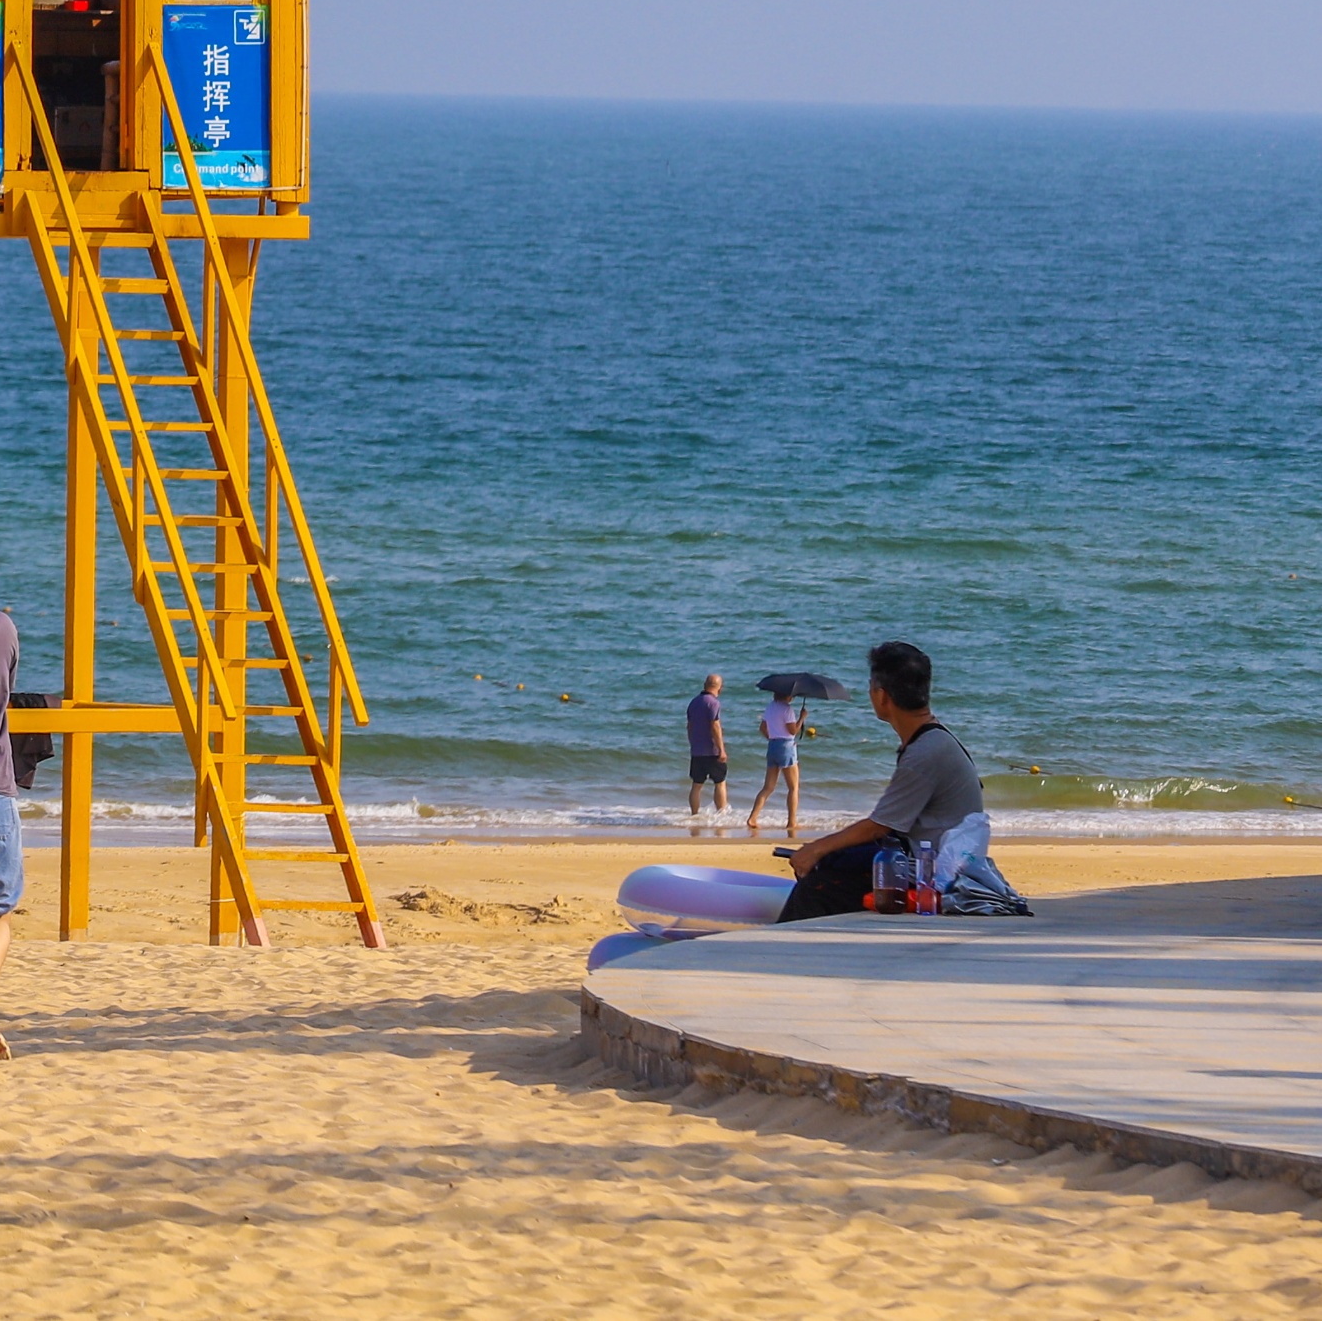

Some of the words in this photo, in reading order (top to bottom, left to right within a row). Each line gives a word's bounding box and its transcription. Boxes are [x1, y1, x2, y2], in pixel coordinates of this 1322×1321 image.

[203, 44, 231, 148] 指挥亭
[173, 163, 229, 174] Cmand
